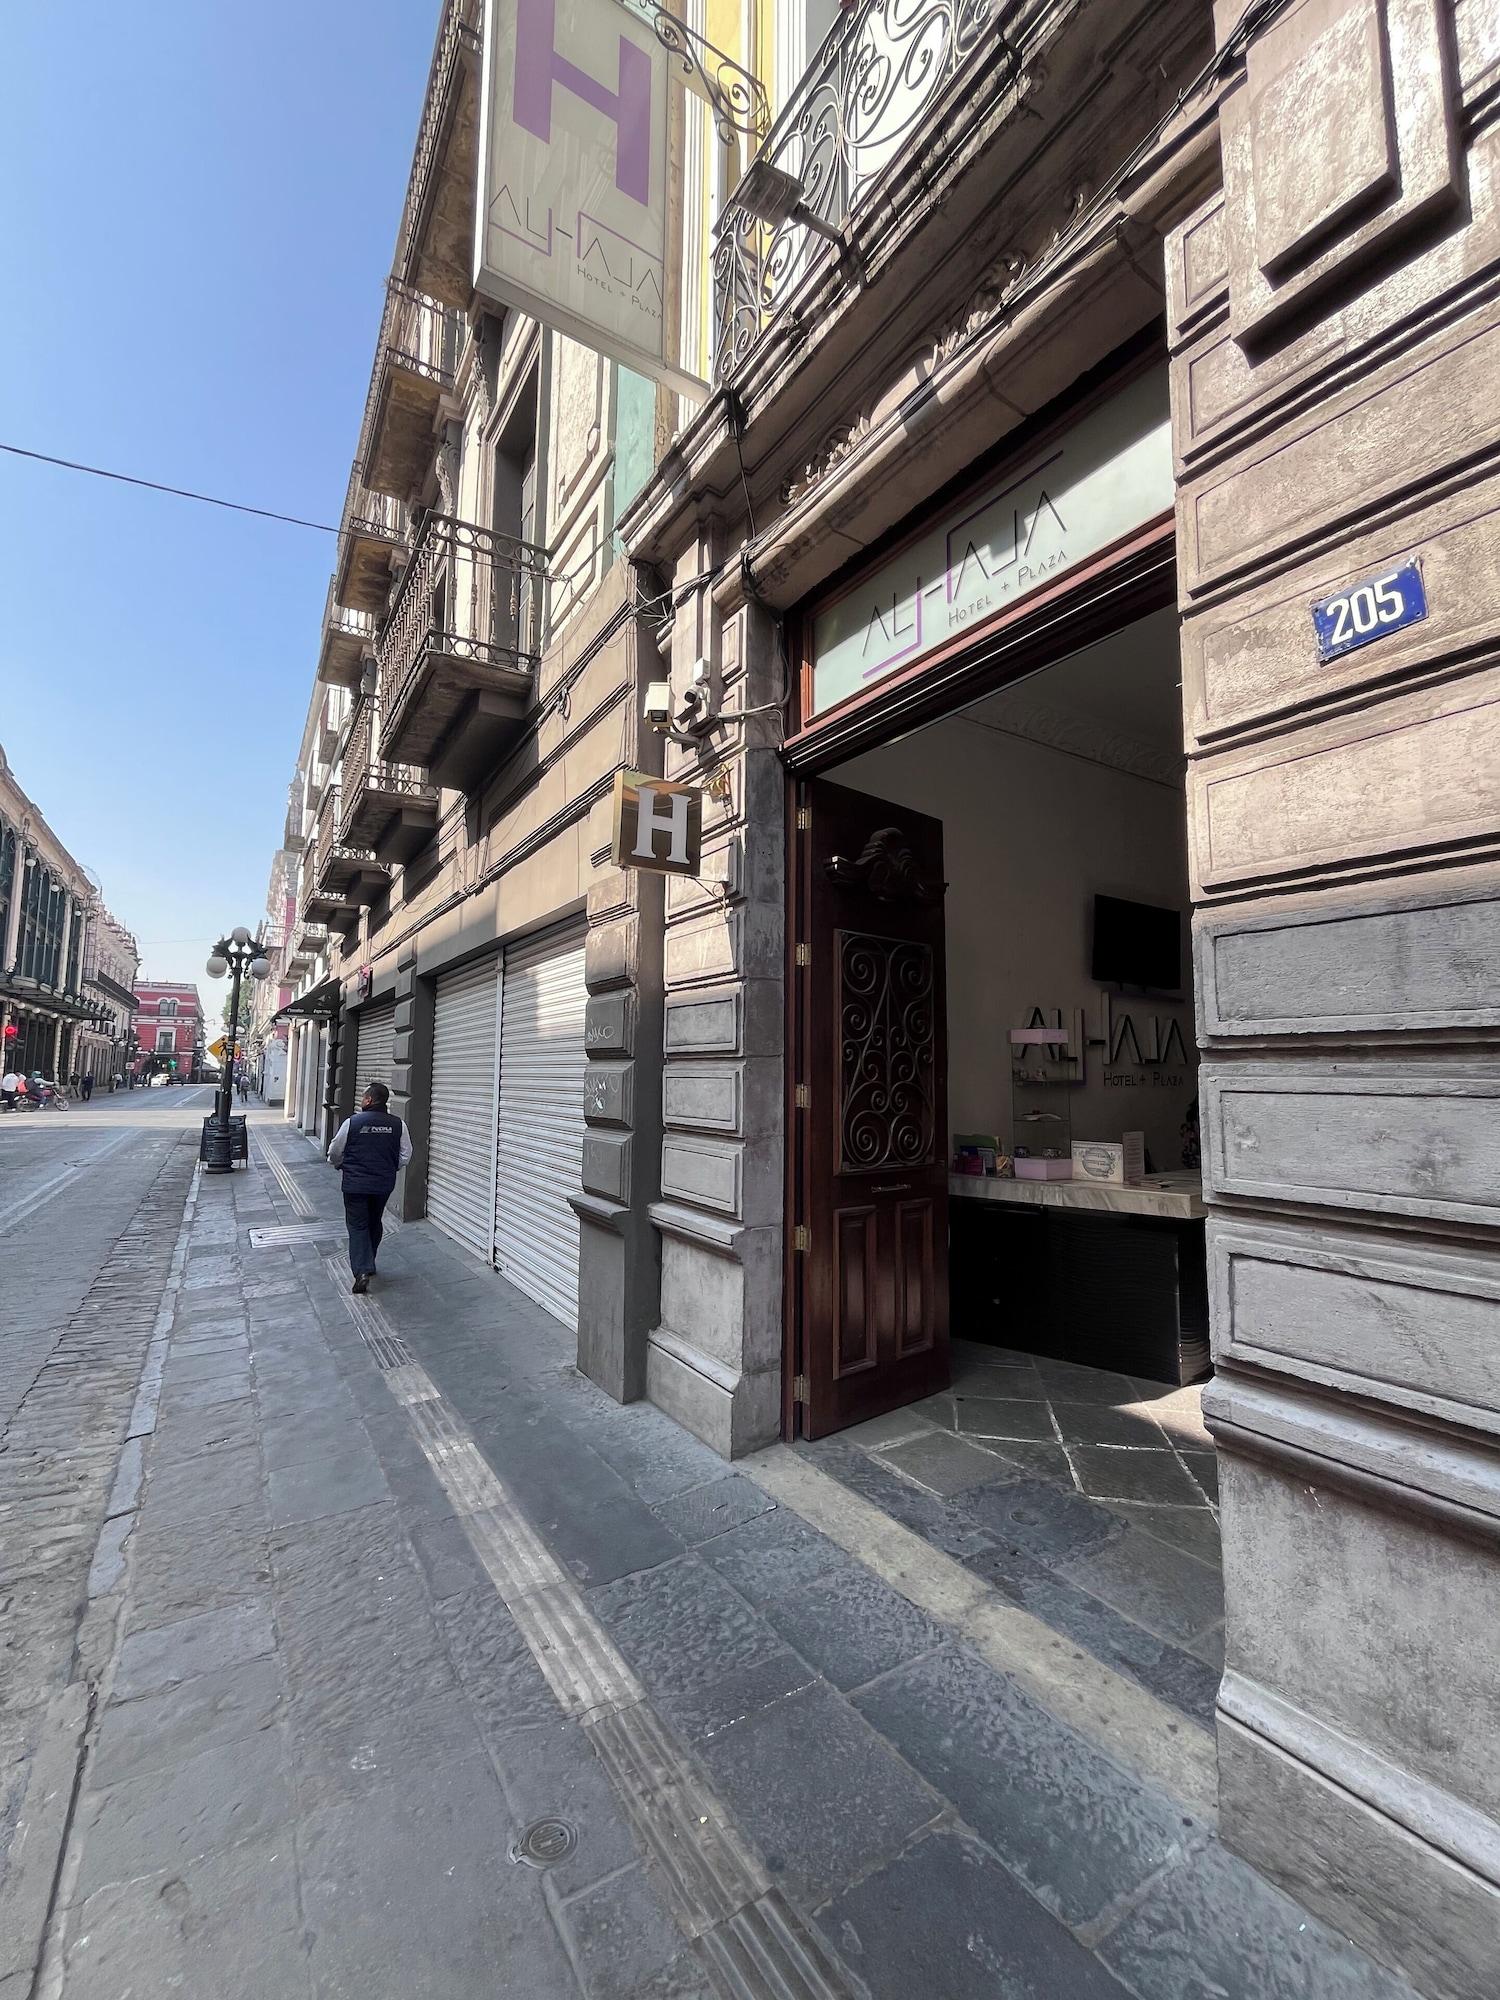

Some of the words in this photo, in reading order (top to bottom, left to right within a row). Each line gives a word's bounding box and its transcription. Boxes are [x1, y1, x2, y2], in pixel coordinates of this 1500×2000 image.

[513, 0, 651, 208] H
[577, 264, 613, 294] HOTEL
[948, 594, 992, 628] HOTEL
[1018, 550, 1068, 586] PLAZA
[1326, 573, 1405, 646] 205
[631, 785, 692, 865] H
[1103, 1072, 1137, 1088] HOTEL
